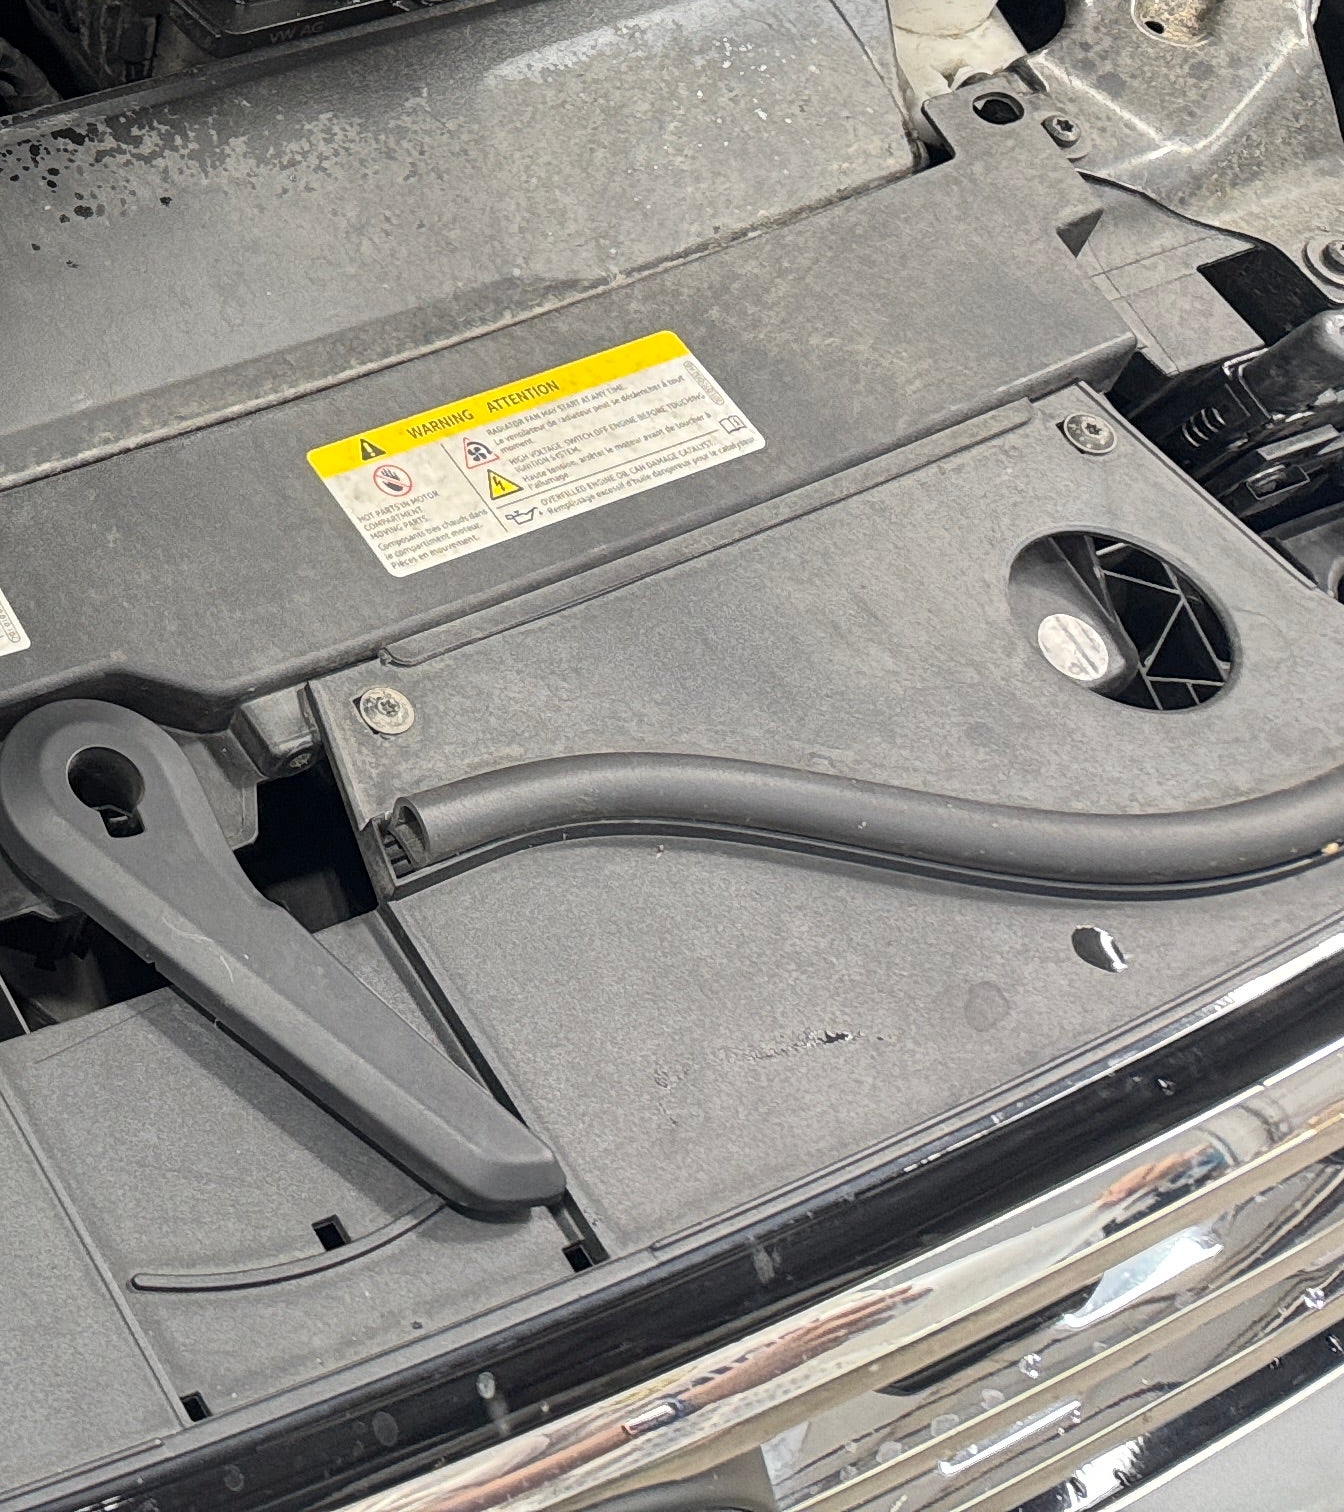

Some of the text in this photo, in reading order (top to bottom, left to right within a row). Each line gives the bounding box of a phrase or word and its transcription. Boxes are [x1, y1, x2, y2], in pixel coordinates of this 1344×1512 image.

[407, 380, 559, 439] WARNING ATTENTION
[565, 431, 593, 445] SWITCH
[358, 512, 373, 522] HOT
[410, 490, 438, 504] MOTOR
[370, 524, 402, 539] MOVING
